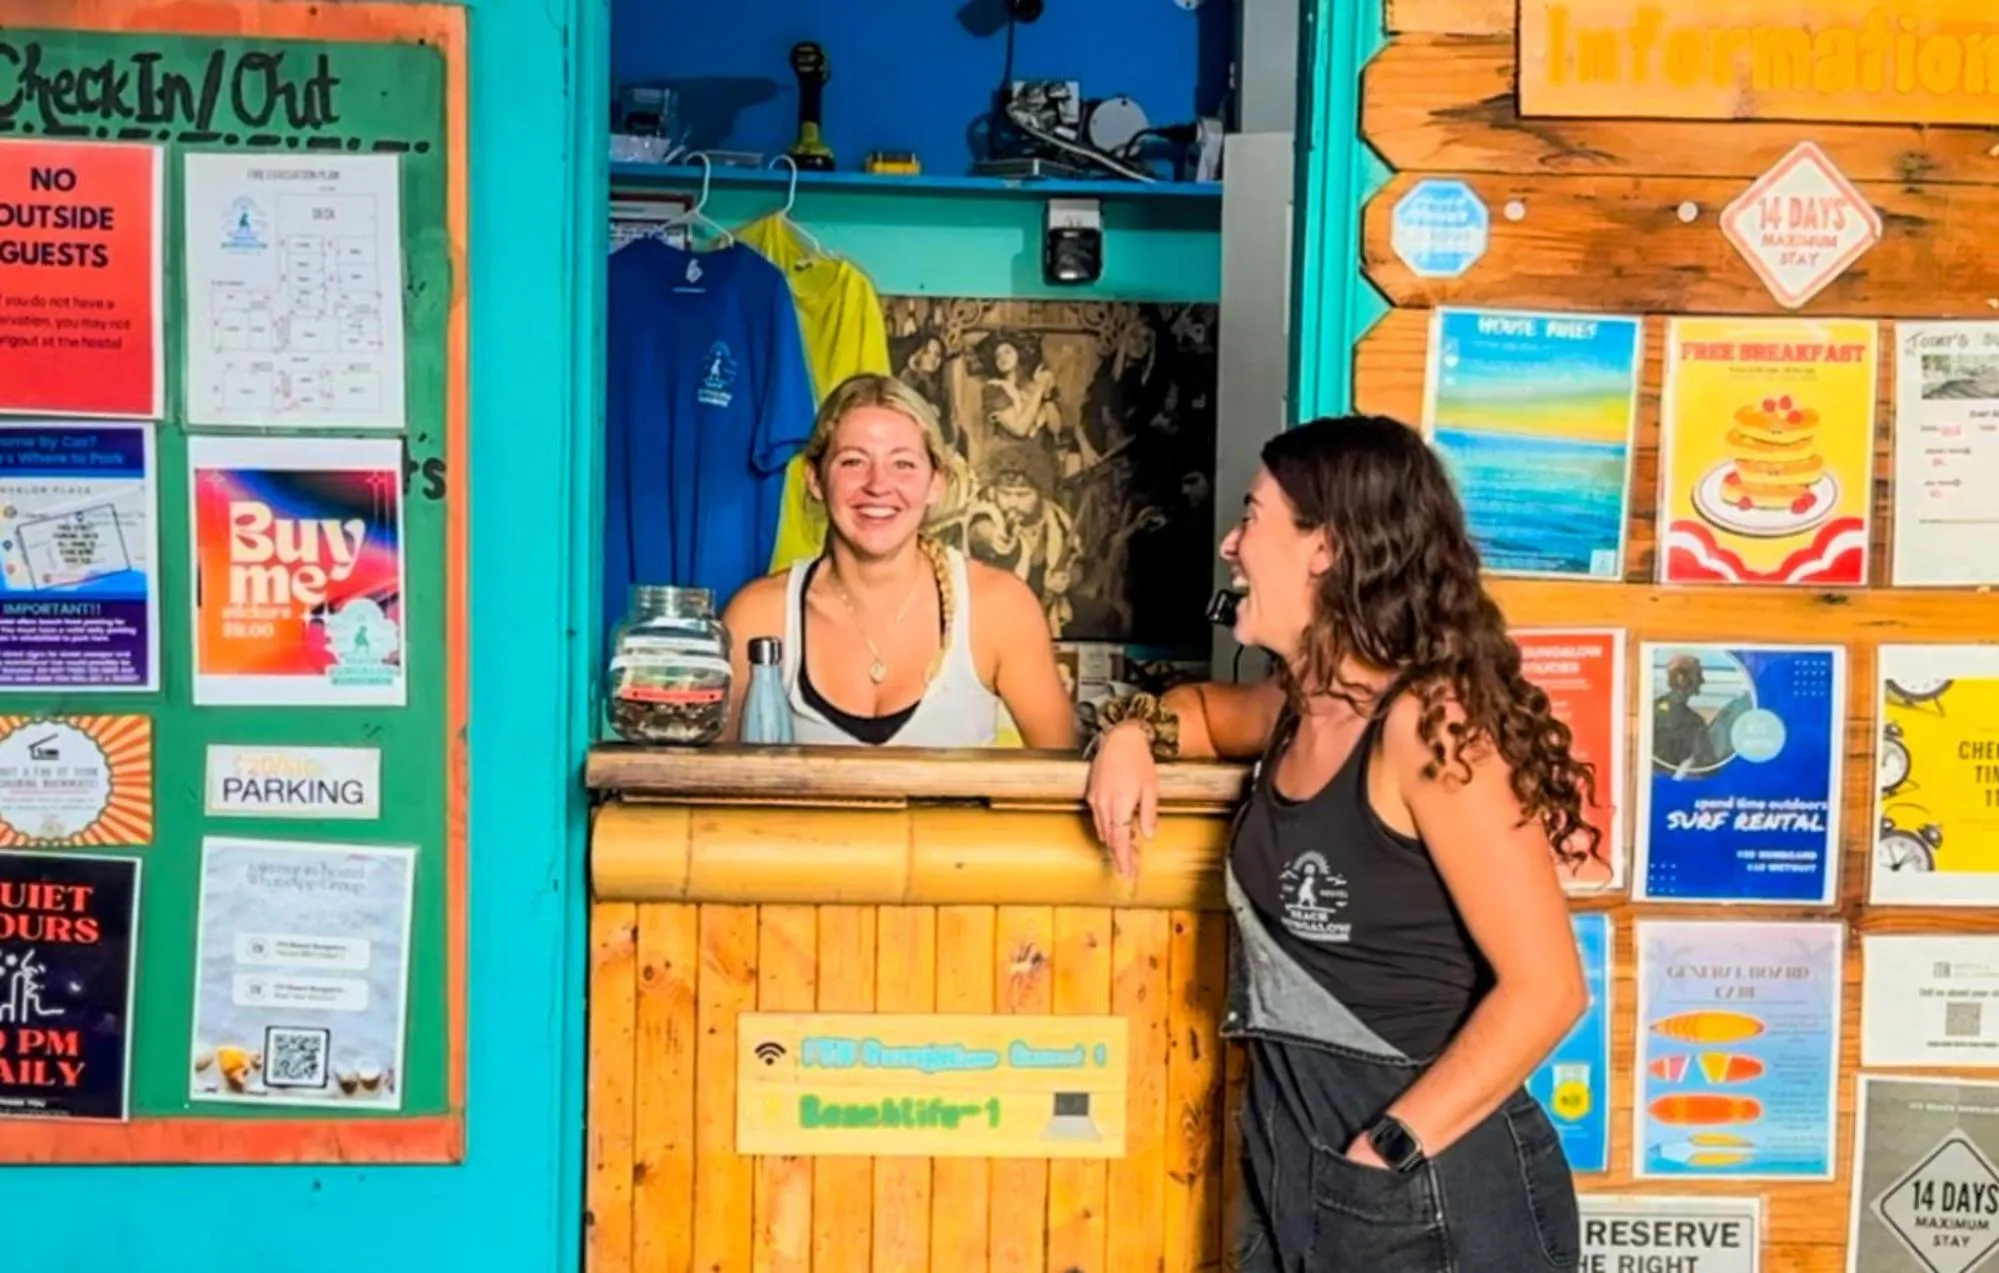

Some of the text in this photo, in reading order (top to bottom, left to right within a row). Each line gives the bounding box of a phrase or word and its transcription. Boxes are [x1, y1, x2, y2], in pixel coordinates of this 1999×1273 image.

[1547, 4, 1999, 94] Information
[30, 168, 77, 192] NO
[1760, 196, 1845, 231] 14 DAYS
[1761, 234, 1838, 248] MAXIMUM
[0, 241, 110, 269] GUESTS
[1778, 252, 1820, 266] STAY
[1681, 343, 1866, 363] FREE BREAKFAST
[229, 500, 366, 582] Buy
[229, 563, 328, 606] me
[1958, 739, 1999, 760] CHE
[222, 777, 365, 806] PARKING
[1666, 811, 1825, 832] SURF RENTAL
[18, 1028, 78, 1057] PM
[1911, 1179, 1999, 1215] 14 DAYS
[1585, 1219, 1741, 1248] RESERVE
[1914, 1215, 1990, 1231] MAXIMUM
[1932, 1234, 1972, 1248] STAY
[1618, 1254, 1699, 1273] RIGHT
